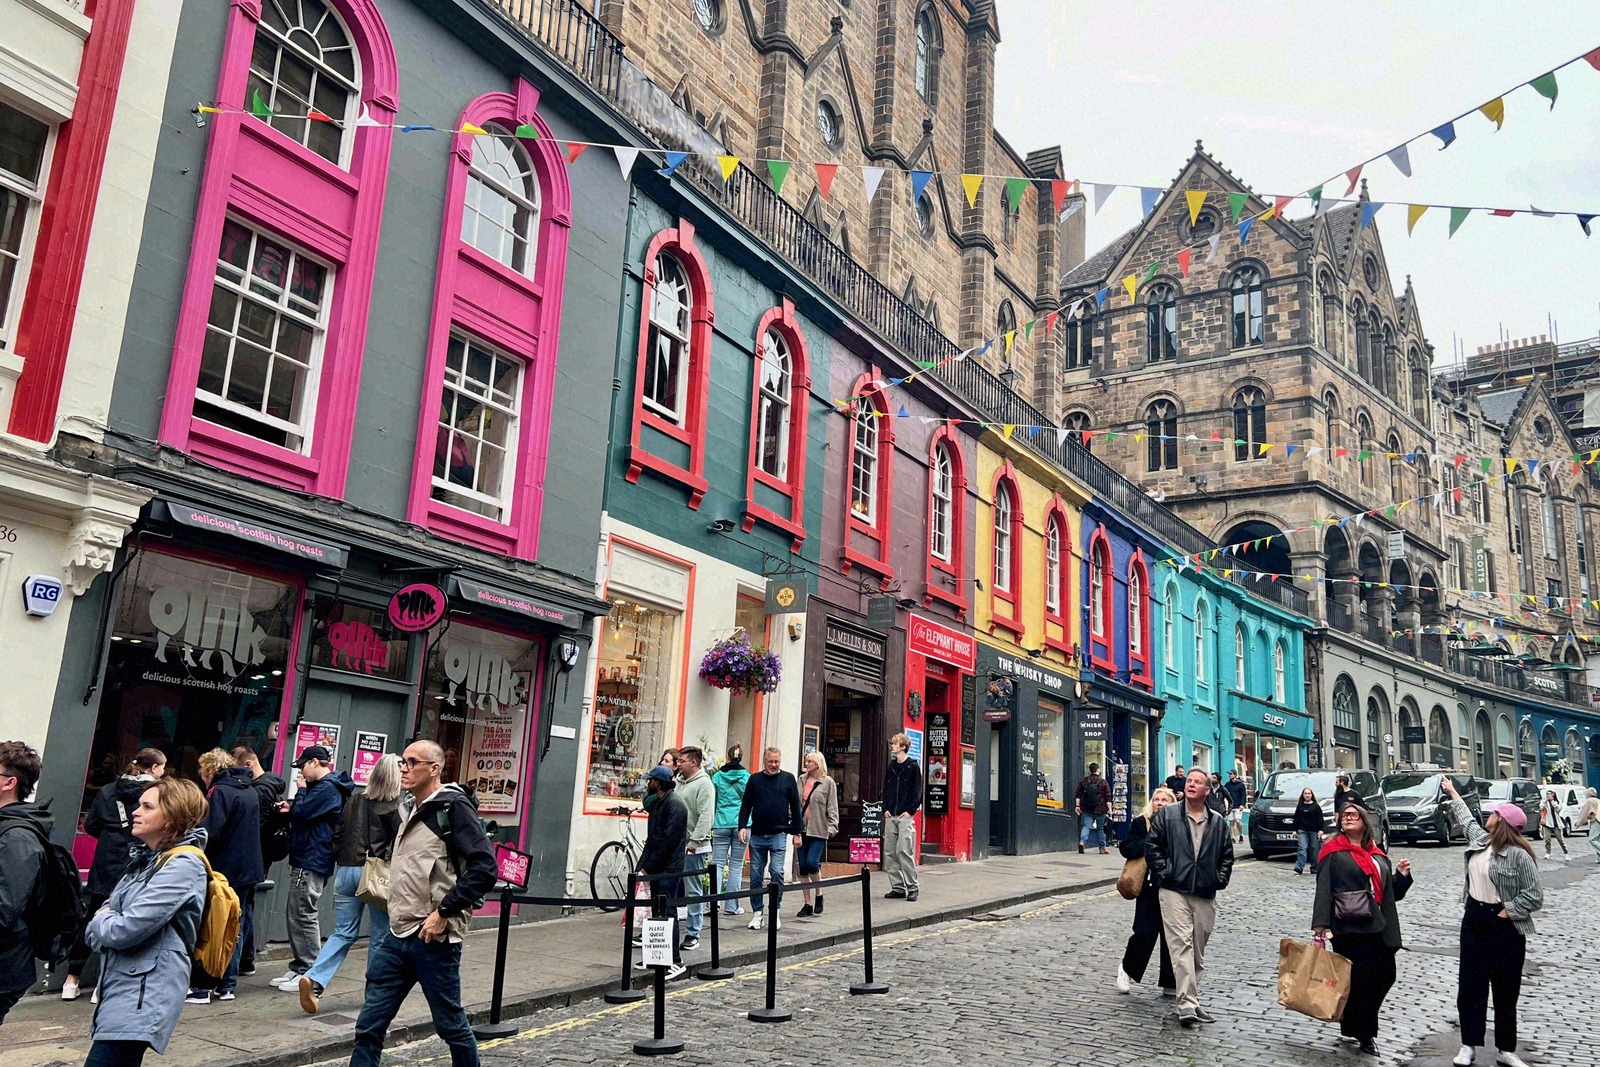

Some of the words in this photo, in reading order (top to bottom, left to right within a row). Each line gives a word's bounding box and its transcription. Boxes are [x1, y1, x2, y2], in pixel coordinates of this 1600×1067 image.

[190, 512, 236, 531] delicious
[238, 525, 275, 543] scottish
[277, 536, 295, 550] hog
[296, 543, 323, 557] roasts
[1476, 548, 1485, 584] SCOTTS
[34, 585, 58, 601] RG
[477, 590, 506, 605] delicious
[507, 600, 532, 612] scottish
[532, 605, 545, 617] hog
[545, 611, 563, 620] roasts
[913, 622, 928, 640] The
[925, 628, 954, 651] ELEPHANT
[954, 638, 971, 658] HOUSE
[867, 641, 881, 656] SON
[998, 656, 1013, 672] THE
[1013, 659, 1043, 683] WHISKY
[1043, 673, 1062, 690] SHOP
[142, 671, 181, 684] delicious
[182, 679, 215, 689] scottish
[217, 682, 232, 694] hog
[234, 686, 258, 695] roasts
[1533, 676, 1557, 690] SCOTTS
[440, 713, 465, 723] delicious
[1080, 721, 1107, 729] WHISKY
[1263, 712, 1287, 728] SWISH
[473, 750, 517, 759] #posewiththepig
